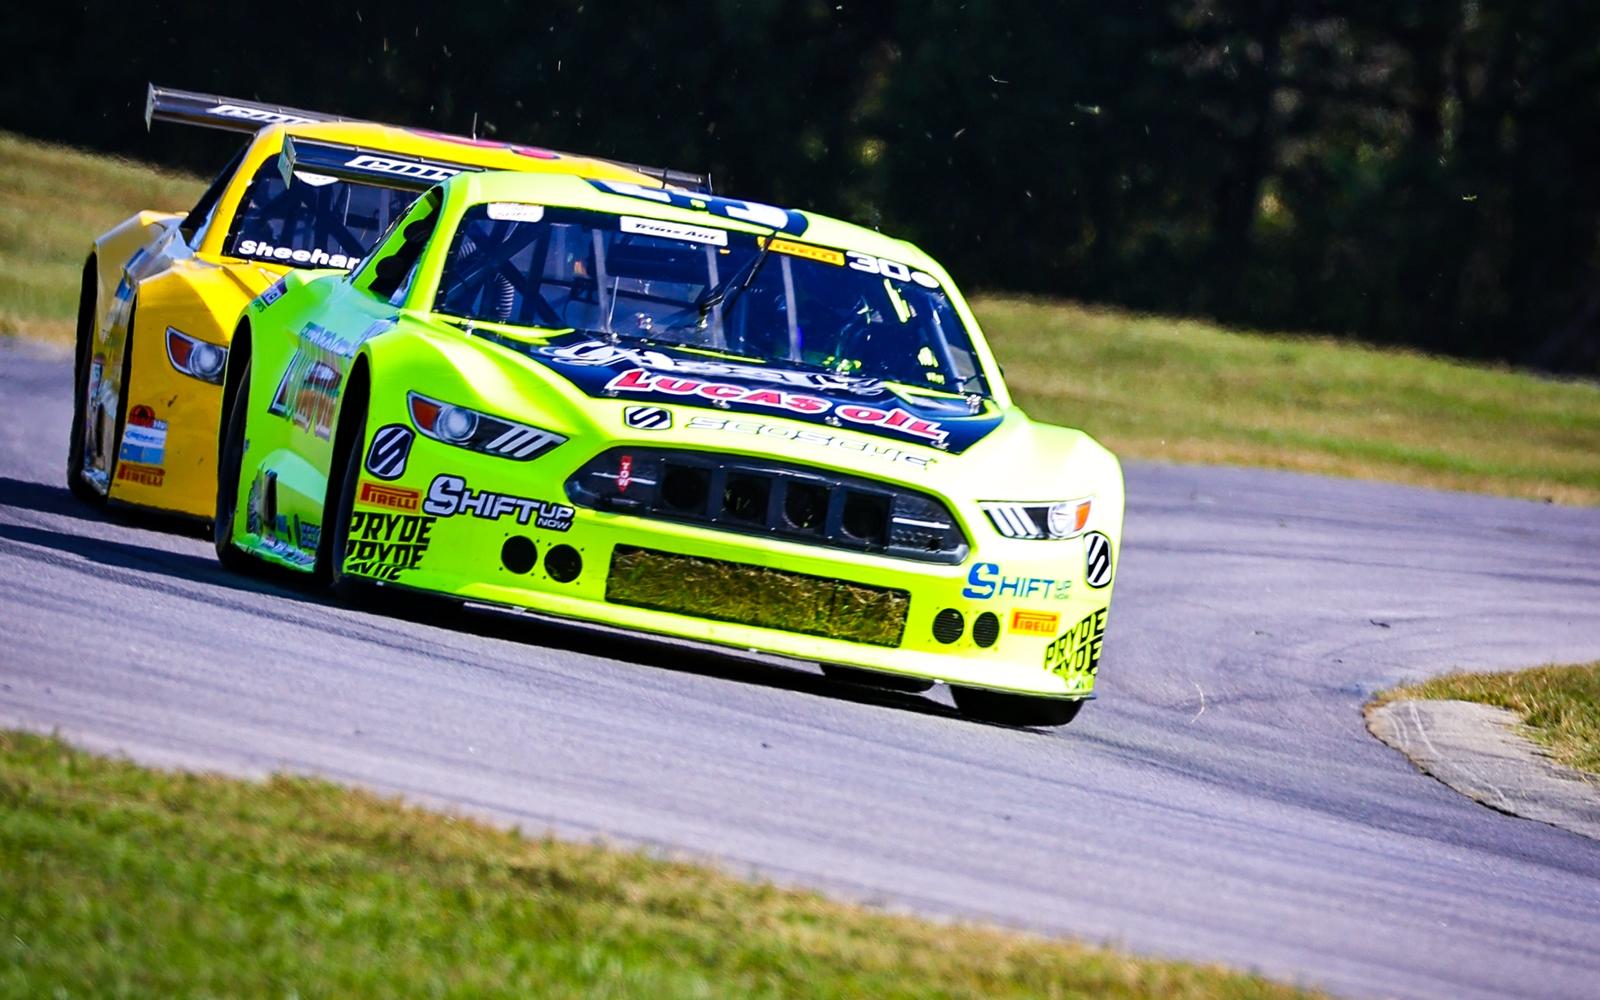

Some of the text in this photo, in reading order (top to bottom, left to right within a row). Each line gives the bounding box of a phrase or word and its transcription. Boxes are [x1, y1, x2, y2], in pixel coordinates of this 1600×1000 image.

[605, 368, 833, 414] LUCAS
[836, 403, 949, 440] OIL
[360, 482, 420, 510] PIRELLI
[422, 475, 575, 523] SHIFT UP
[350, 511, 437, 544] PRYDE
[536, 516, 570, 530] NOW
[962, 562, 1054, 600] SHIFT
[1012, 611, 1057, 633] PIRELLI
[1044, 606, 1107, 670] PRYDE
